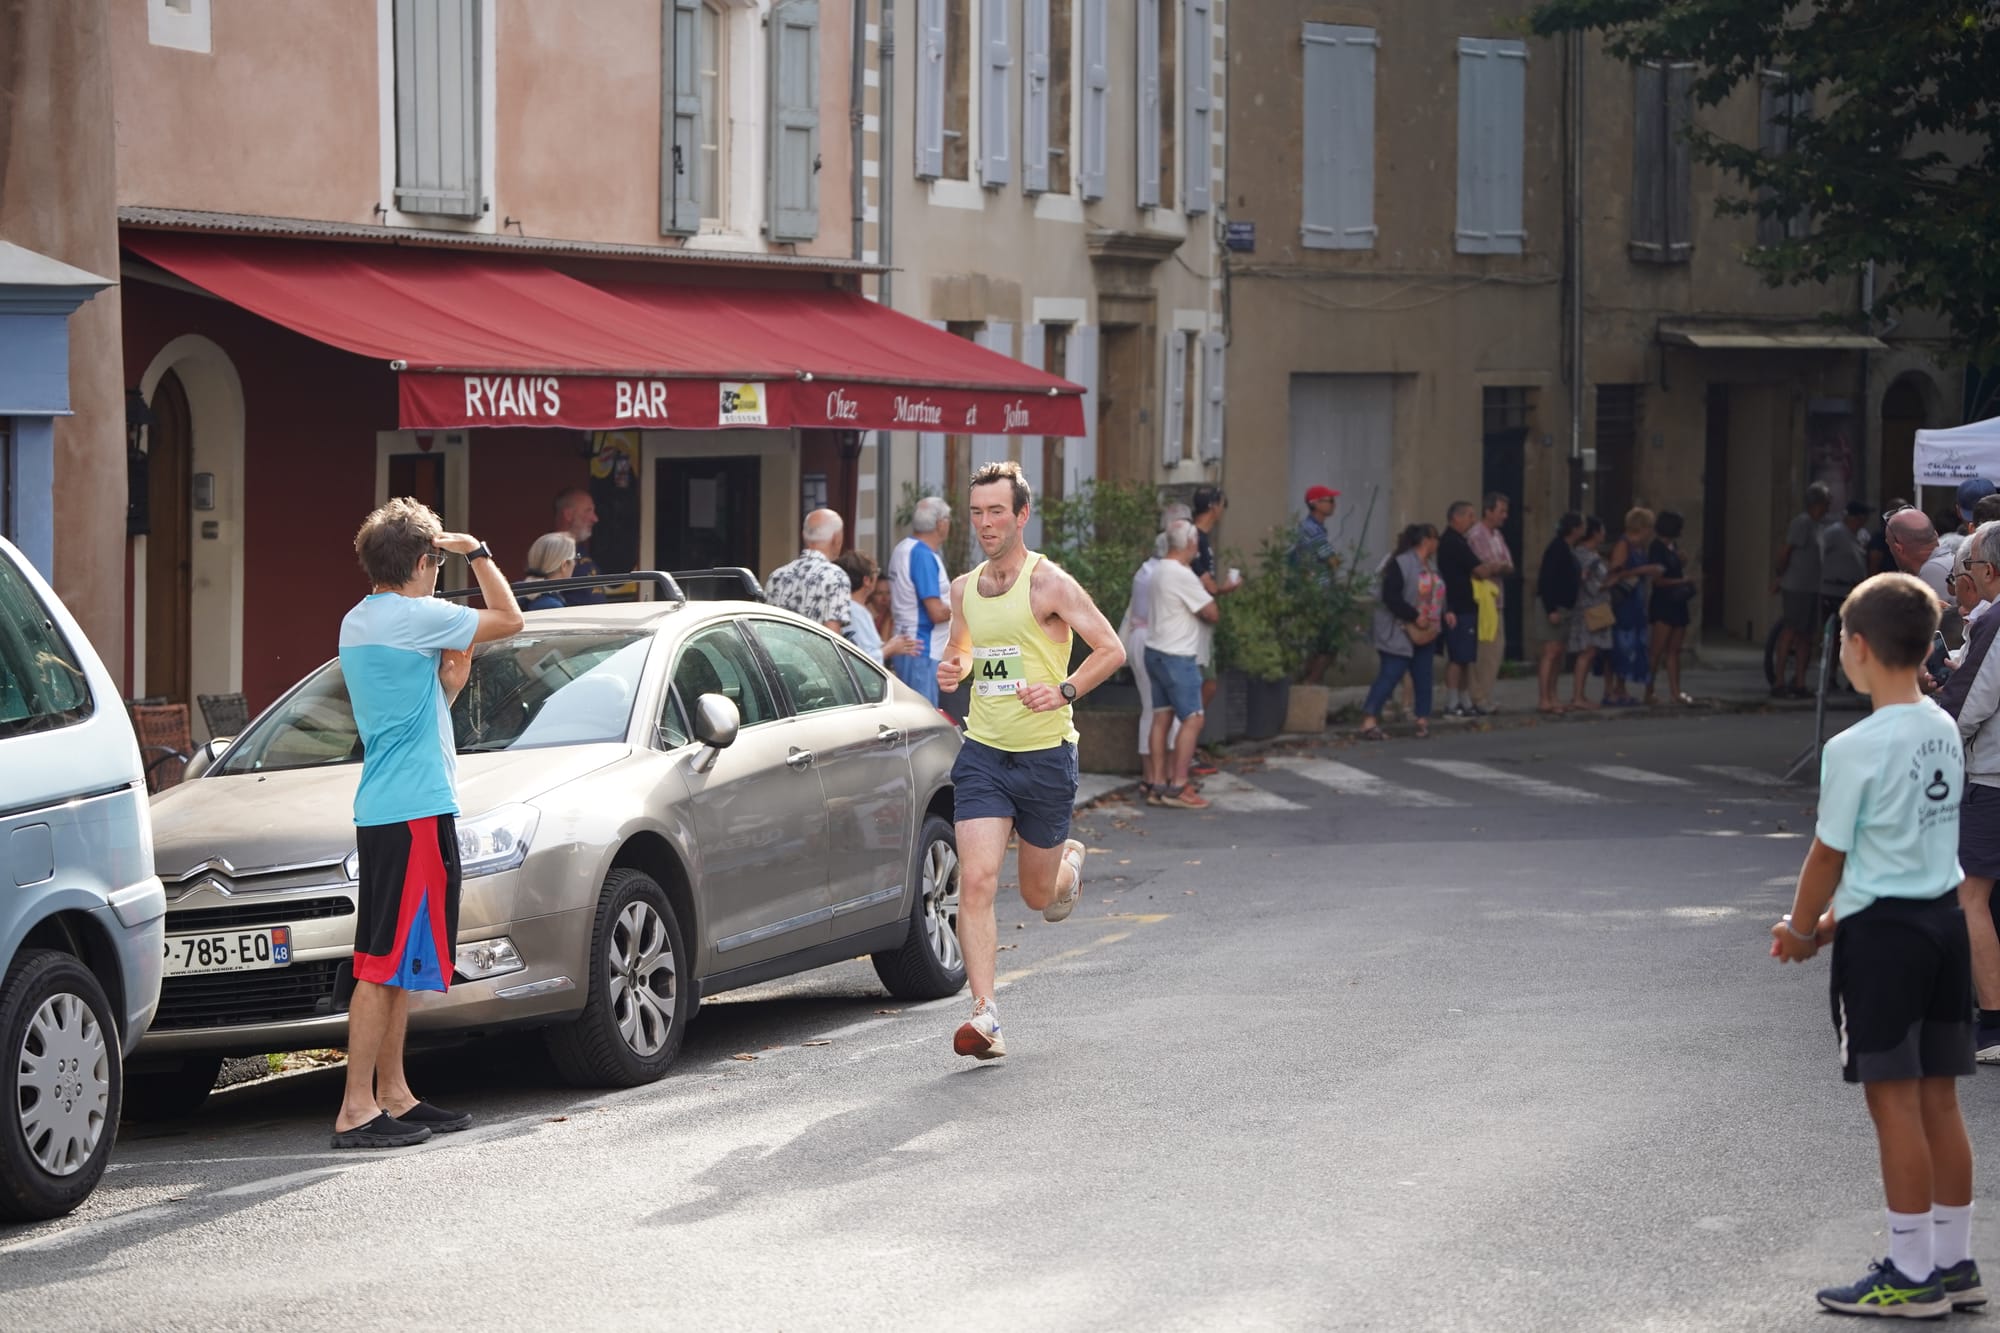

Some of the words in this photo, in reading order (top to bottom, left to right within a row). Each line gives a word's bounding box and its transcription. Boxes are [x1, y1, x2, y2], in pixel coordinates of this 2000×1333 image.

[464, 377, 560, 416] RYAN'S
[616, 381, 667, 418] BAR
[826, 389, 858, 420] Chez
[893, 396, 941, 424] Martine
[965, 404, 977, 425] et
[1003, 400, 1029, 431] John
[983, 660, 1008, 679] 44
[274, 947, 288, 961] 48
